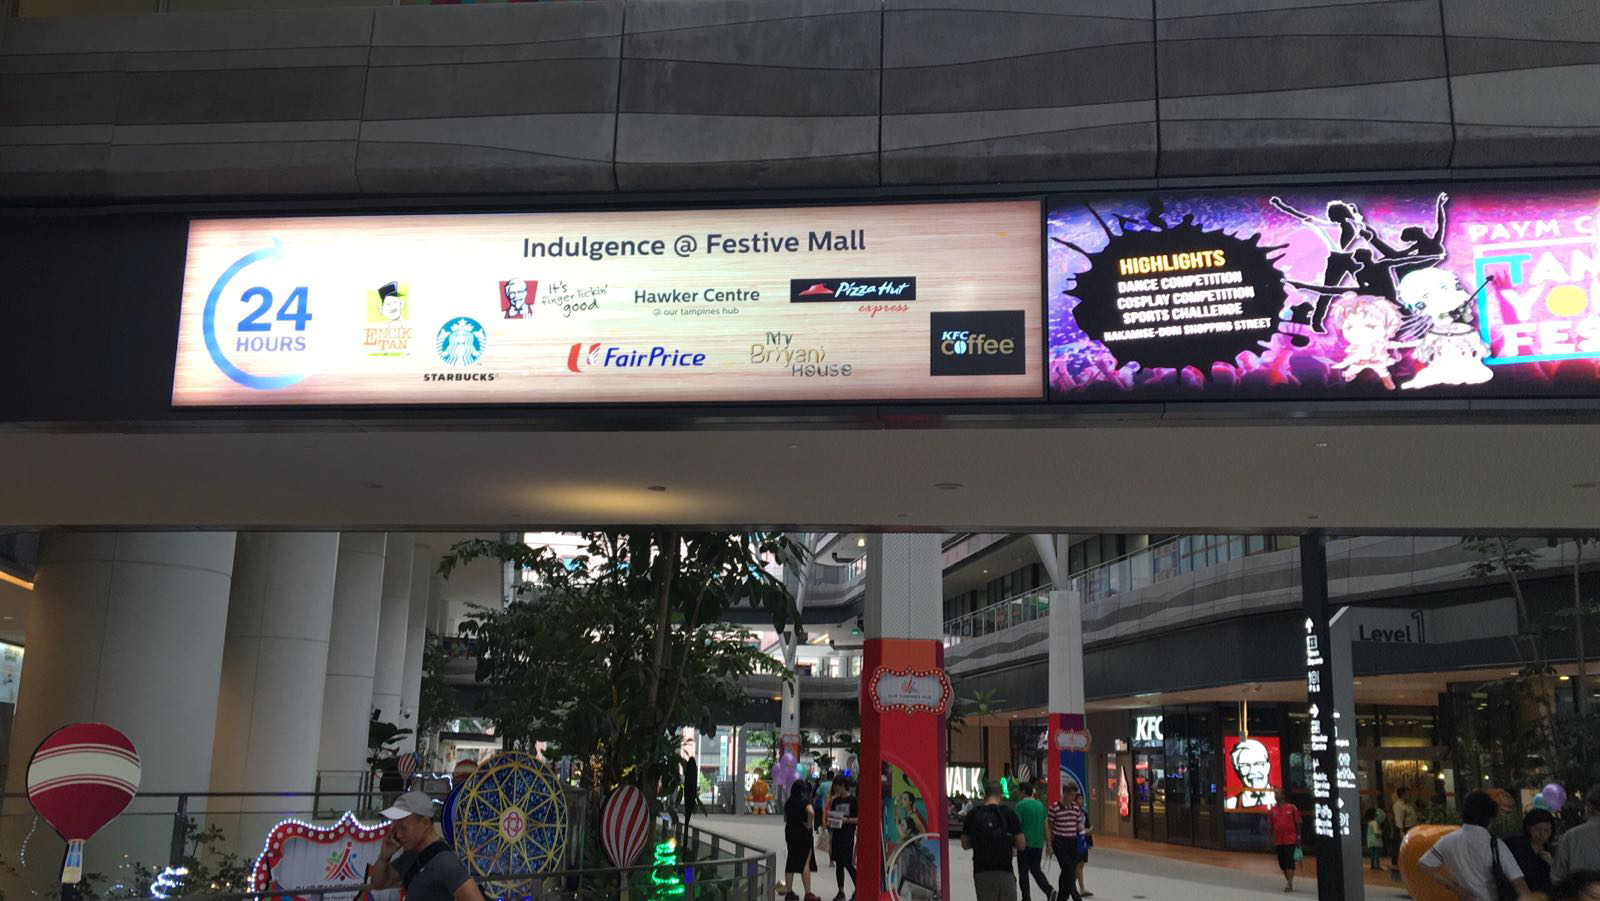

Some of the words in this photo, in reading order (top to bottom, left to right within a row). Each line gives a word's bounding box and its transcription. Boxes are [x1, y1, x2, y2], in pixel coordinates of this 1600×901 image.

[1468, 218, 1560, 243] PAYM
[523, 236, 666, 261] Indulgence
[674, 234, 698, 257] @
[706, 231, 799, 254] Festive
[808, 229, 866, 251] Mall
[1119, 249, 1226, 276] HIGHLIGHTS
[549, 281, 568, 294] It's
[834, 281, 877, 298] Pizza
[877, 281, 909, 297] Hut
[1117, 278, 1159, 294] DANCE
[1160, 271, 1243, 290] COMPETITION
[542, 293, 575, 307] finger
[634, 289, 698, 304] Hawker
[703, 288, 760, 303] Centre
[1117, 294, 1170, 310] COSPLAY
[1172, 286, 1255, 305] COMPETITION
[237, 286, 313, 332] 24
[563, 299, 600, 317] good
[680, 308, 720, 317] tampines
[722, 307, 740, 315] hub
[858, 304, 911, 318] express
[1123, 309, 1170, 325] SPORTS
[1171, 303, 1243, 320] CHALLENGE
[941, 331, 970, 340] KFC
[1183, 321, 1233, 335] SHOPPING
[1234, 318, 1272, 331] STREET
[236, 336, 306, 353] HOURS
[383, 340, 408, 351] TAN
[765, 331, 793, 349] My
[604, 346, 706, 368] FairPrice
[423, 373, 495, 381] STARBUCKS
[1359, 624, 1412, 643] Level
[1136, 715, 1164, 740] KFC
